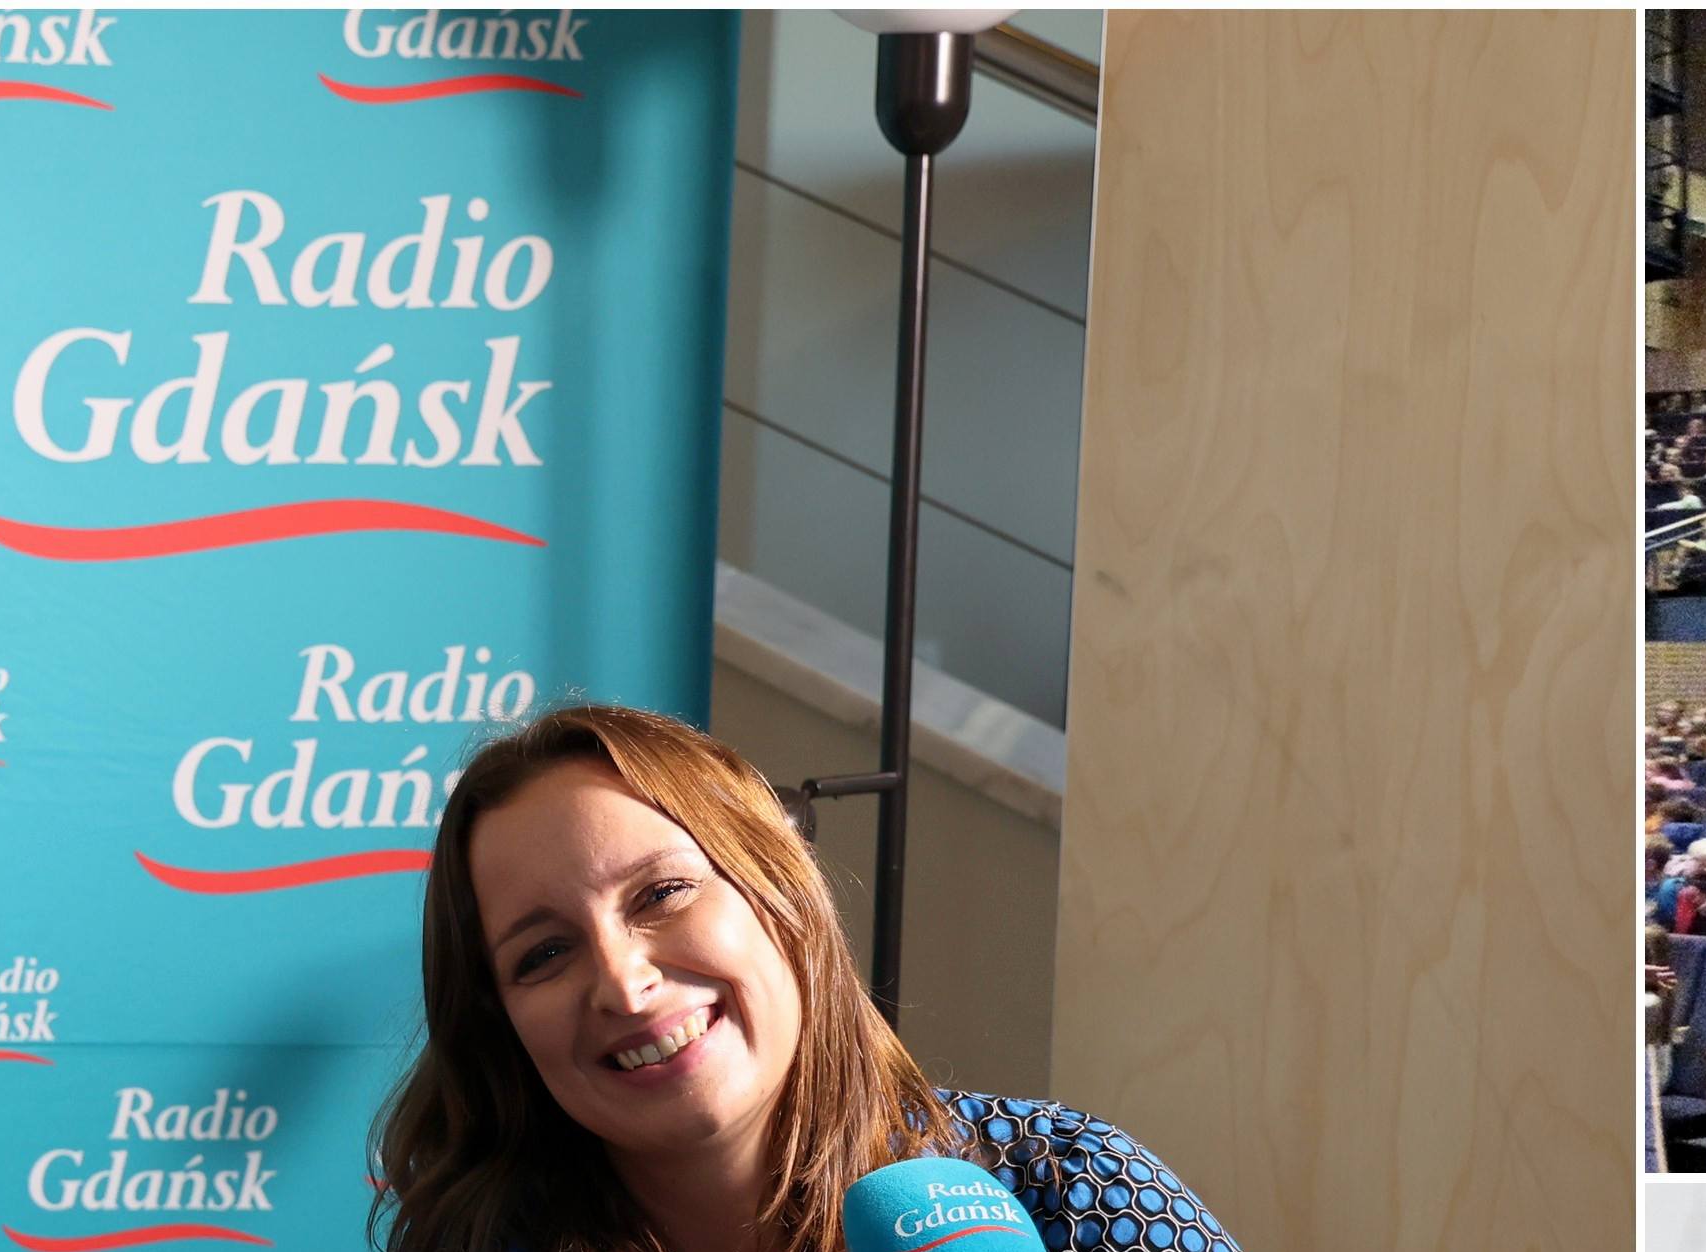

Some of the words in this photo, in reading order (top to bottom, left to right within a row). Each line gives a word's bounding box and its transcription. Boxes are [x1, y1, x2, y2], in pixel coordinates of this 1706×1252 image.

[188, 189, 554, 311] Radio
[12, 327, 554, 469] Gdańsk
[290, 643, 536, 725] Radio
[172, 736, 456, 829] Gdań
[108, 1086, 278, 1141] Radio
[27, 1148, 278, 1211] Gdańsk
[926, 1181, 1009, 1200] Radio
[894, 1202, 1024, 1238] Gdańsk
